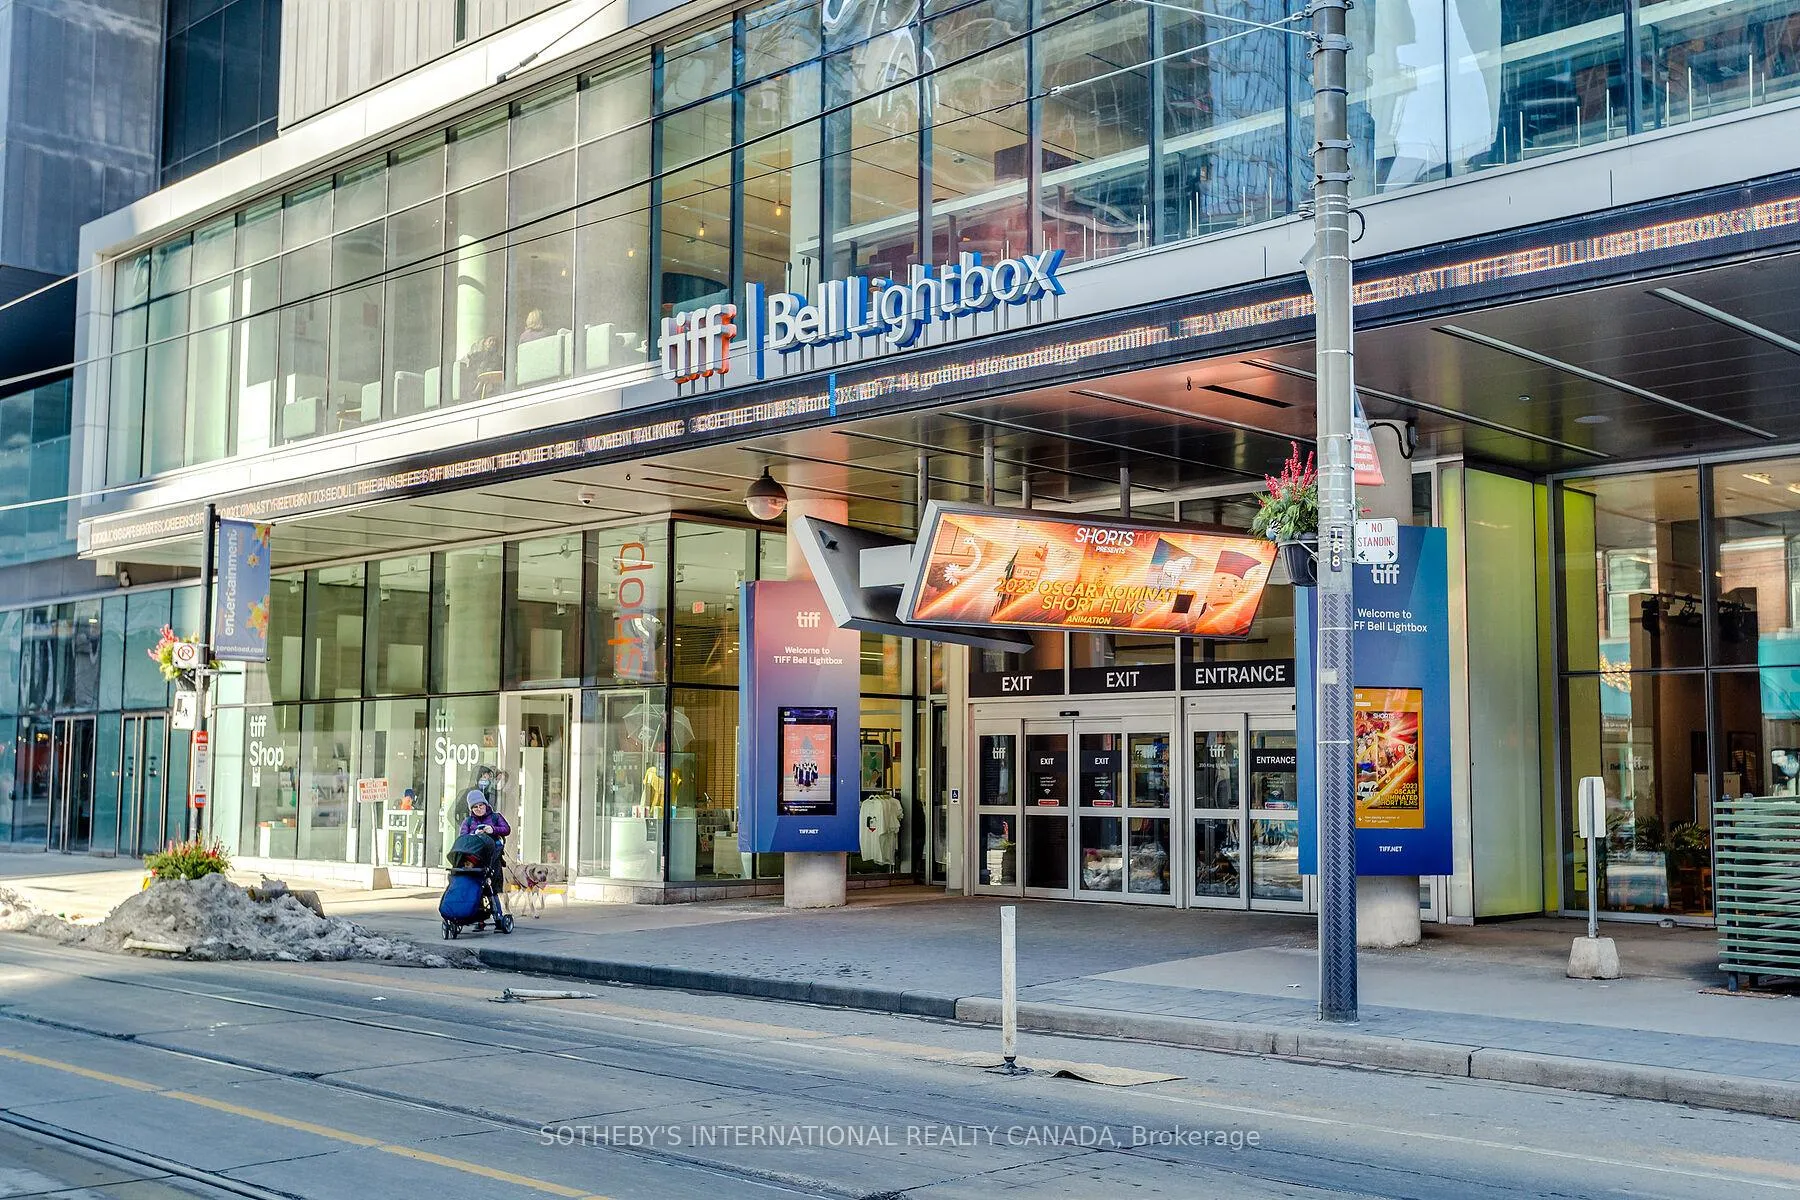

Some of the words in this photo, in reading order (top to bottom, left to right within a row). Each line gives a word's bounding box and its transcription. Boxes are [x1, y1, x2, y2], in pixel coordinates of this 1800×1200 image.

[659, 303, 737, 382] tiff
[768, 279, 849, 353] Bell
[847, 248, 1067, 348] Lightbox
[1371, 523, 1383, 533] NO
[1357, 536, 1395, 547] STANDING
[1096, 546, 1126, 554] PRESENTS
[1371, 564, 1400, 585] tiff
[223, 529, 239, 636] entertainment
[994, 577, 1037, 595] 2023
[1041, 595, 1097, 611] SHORT
[1100, 598, 1147, 615] FILMS
[796, 611, 822, 628] tiff
[1065, 615, 1112, 625] ANIMATION
[1357, 608, 1400, 619] Welcome
[1402, 610, 1412, 619] to
[1367, 622, 1385, 631] Bell
[1388, 623, 1428, 634] Lightbox
[784, 646, 820, 655] Welcome
[821, 647, 831, 655] to
[773, 656, 792, 664] TIFF
[793, 656, 808, 664] Bell
[809, 656, 843, 666] Lightbox
[1106, 671, 1140, 688] EXIT
[1195, 665, 1286, 685] ENTRANCE
[1002, 676, 1033, 692] EXIT
[249, 715, 267, 738] tiff
[249, 740, 285, 772] Shop
[434, 737, 480, 772] Shop
[991, 747, 1006, 760] tiff
[1209, 744, 1226, 758] tiff
[1039, 757, 1055, 765] EXIT
[1094, 757, 1110, 765] EXIT
[1256, 756, 1296, 764] ENTRANCE
